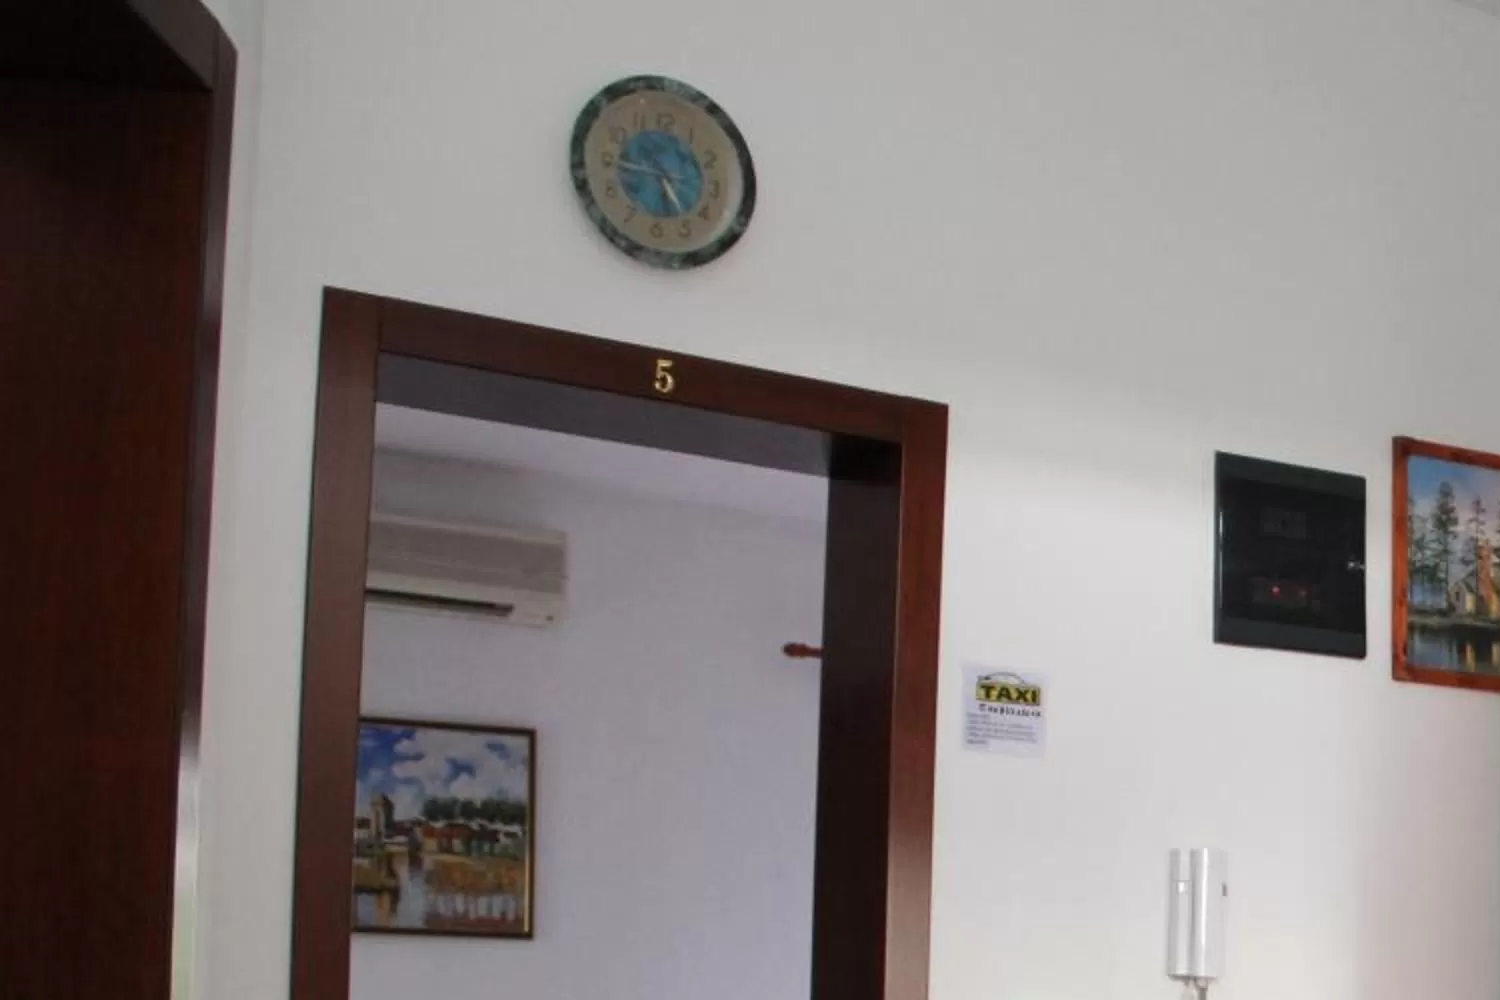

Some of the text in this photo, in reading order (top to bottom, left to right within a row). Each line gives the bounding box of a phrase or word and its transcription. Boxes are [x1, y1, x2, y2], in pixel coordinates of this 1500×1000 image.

[601, 151, 615, 168] 9
[704, 149, 717, 169] 2
[624, 205, 638, 223] 7
[697, 203, 710, 220] 4
[649, 222, 664, 239] 6
[679, 221, 692, 239] 5
[655, 359, 674, 393] 5
[980, 684, 1037, 704] TAXI
